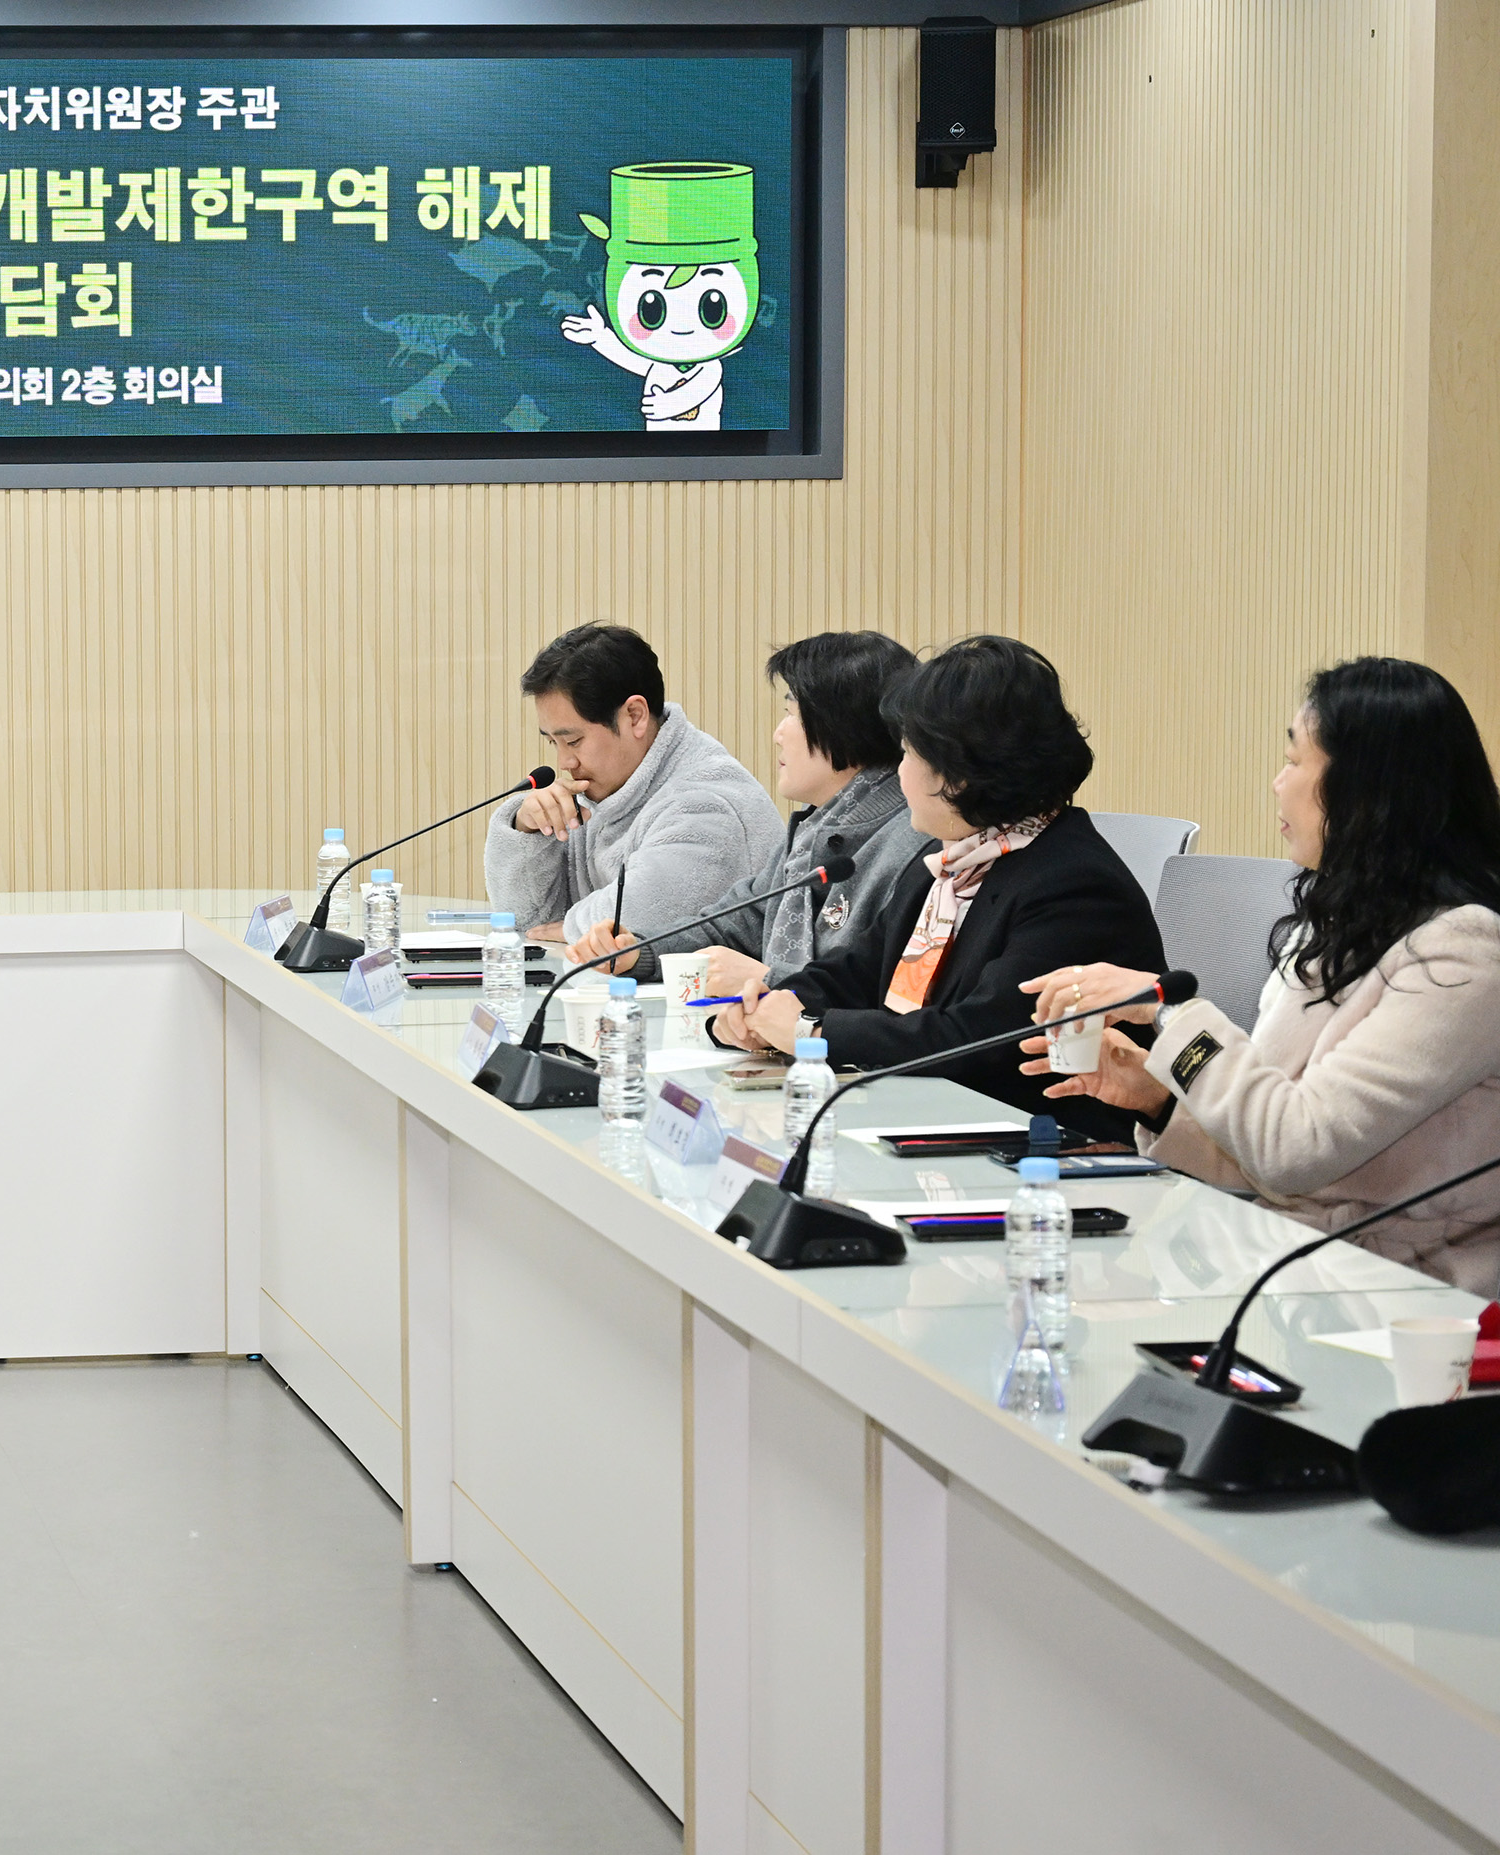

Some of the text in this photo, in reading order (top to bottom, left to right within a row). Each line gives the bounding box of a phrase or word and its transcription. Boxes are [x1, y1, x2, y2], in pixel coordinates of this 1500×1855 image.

[196, 85, 280, 131] 주관
[416, 165, 551, 241] 해제
[61, 367, 117, 405] 2층
[122, 365, 223, 404] 회의실
